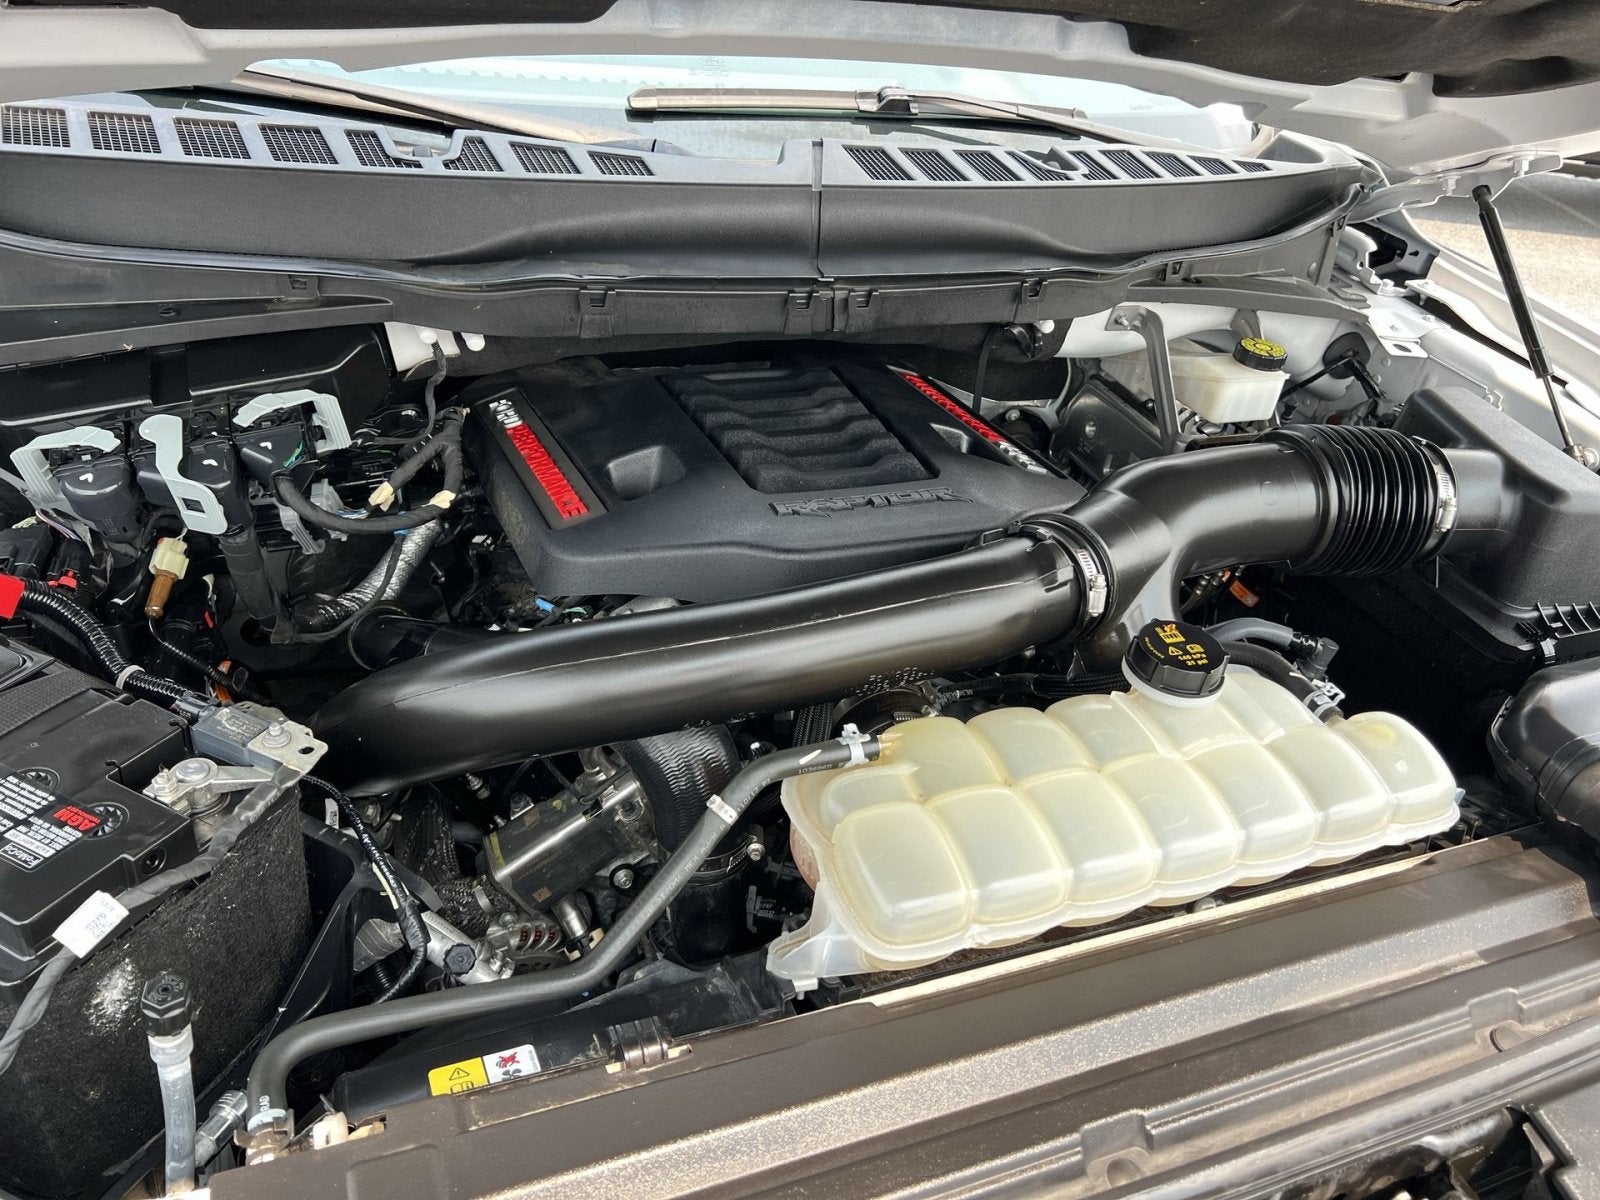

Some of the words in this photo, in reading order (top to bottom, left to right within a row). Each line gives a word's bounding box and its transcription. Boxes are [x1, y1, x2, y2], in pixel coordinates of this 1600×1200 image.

[505, 422, 590, 519] PERFORMANCE
[768, 486, 974, 519] RAPTOR
[53, 808, 97, 831] AGM
[5, 845, 36, 866] FoMoCo
[259, 1095, 270, 1112] RAD
